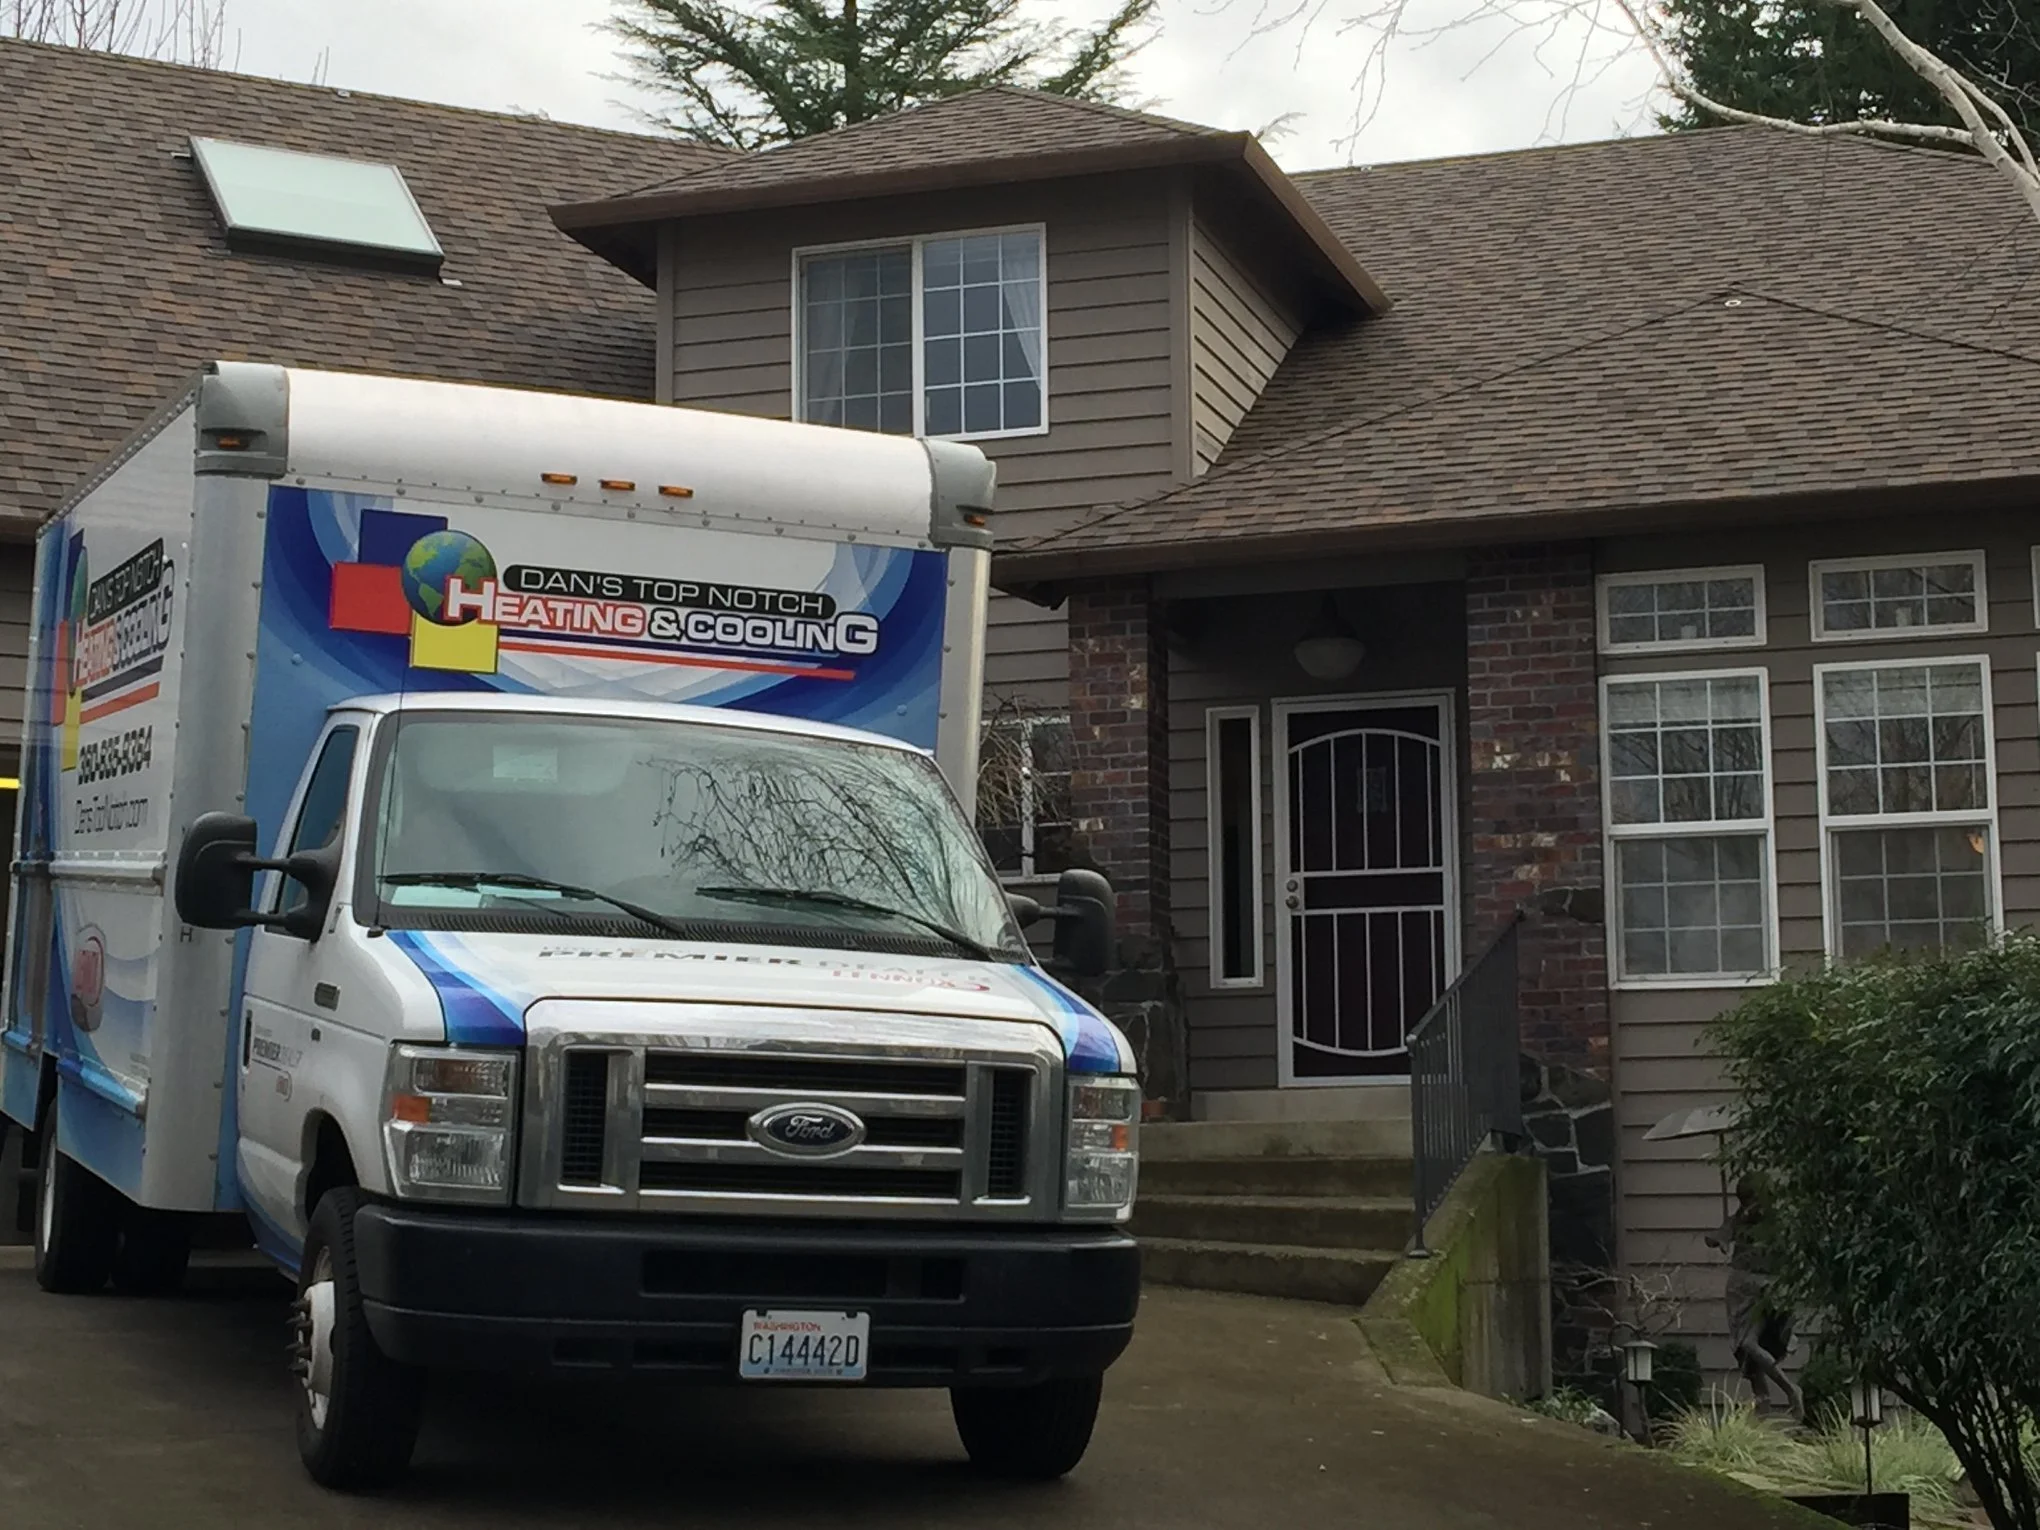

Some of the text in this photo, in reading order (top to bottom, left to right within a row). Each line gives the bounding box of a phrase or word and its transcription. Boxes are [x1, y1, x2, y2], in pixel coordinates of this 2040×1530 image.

[520, 568, 824, 616] DAN'S TOP NOTCH
[446, 577, 880, 656] HEATING & COOLING
[785, 1115, 836, 1138] Ford
[753, 1321, 821, 1332] WASHINGTON
[748, 1333, 860, 1367] C14442D
